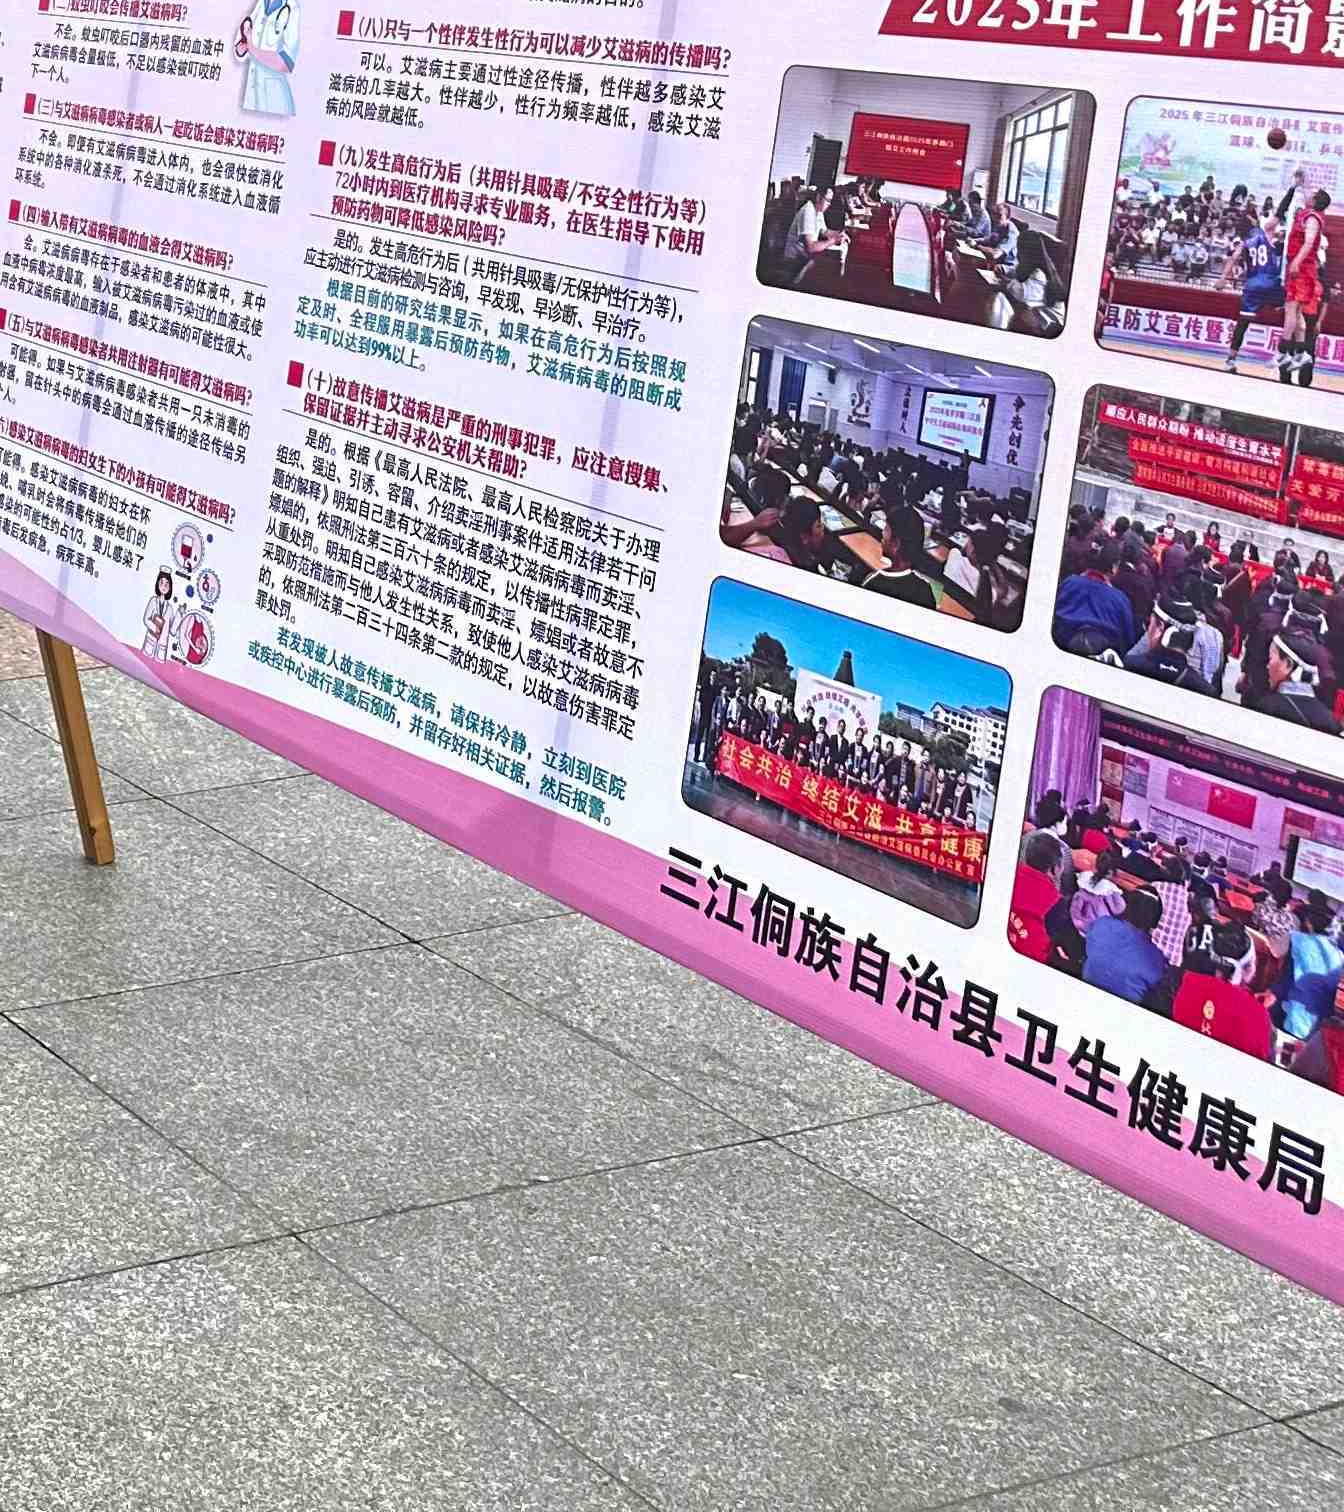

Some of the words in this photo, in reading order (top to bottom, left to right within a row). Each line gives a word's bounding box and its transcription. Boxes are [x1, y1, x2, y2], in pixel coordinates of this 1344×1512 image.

[359, 15, 731, 70] (八)只与一个性伴发生性行为可以减少艾滋病的传播吗?
[325, 97, 424, 130] 病的风险就越低。
[329, 73, 721, 140] 滋病的几率越大。性伴越少，性行为频率越低，感染艾滋
[360, 51, 726, 111] 可以。艾滋病主要通过性途径传播，性伴越多感染艾
[331, 195, 506, 248] 预防药物可降低感染风险吗?
[334, 170, 705, 256] 72小时内到医疗机构寻求专业服务，在医生指导下使用
[304, 249, 647, 343] 应主动进行艾滋病检测与咨询，早发现、早诊断、早治疗。
[326, 278, 687, 383] 根据目前的研究结果显示，如果在高危行为后按照规
[294, 320, 427, 372] 功率可以达到99%以上。
[297, 296, 682, 413] 定及时、全程服用暴露后预防药物，艾滋病病毒的阻断成
[303, 393, 528, 480] 保留证据并主动寻求公安机关帮助?
[304, 428, 661, 563] 是的。根据《最高人民法院、最高人民检察院关于办理
[255, 589, 299, 624] 罪处罚。
[277, 627, 627, 801] 若发现被人故意传播艾滋病，请保持冷静，立刻到医院
[722, 738, 793, 789] 社会共治
[659, 846, 1326, 1216] 三江侗族自治县卫生健康局
